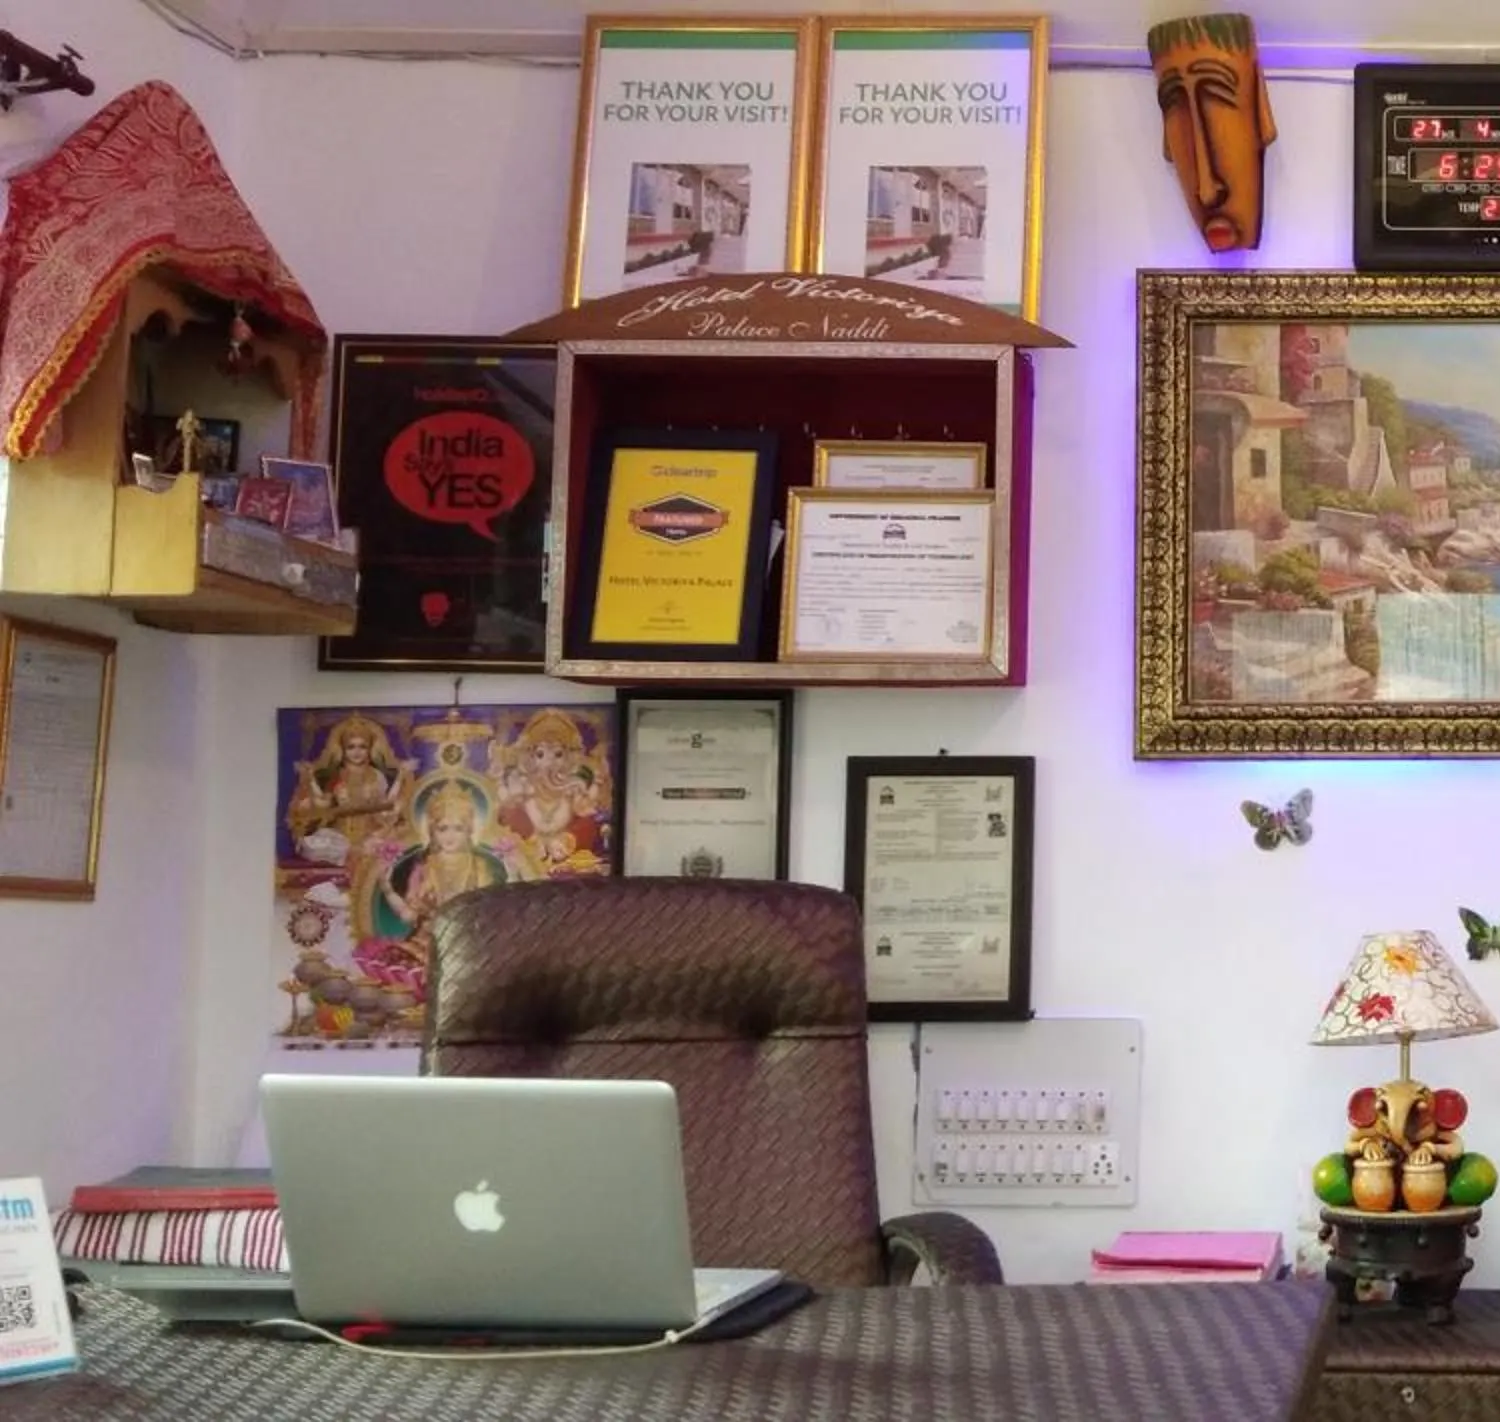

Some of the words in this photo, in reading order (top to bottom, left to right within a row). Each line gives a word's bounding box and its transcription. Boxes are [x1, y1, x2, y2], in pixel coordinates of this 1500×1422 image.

[621, 81, 713, 101] THANK
[720, 81, 775, 101] YOU
[855, 82, 947, 102] THANK
[953, 83, 1008, 103] YOU
[603, 104, 649, 122] FOR
[655, 104, 718, 123] YOUR
[726, 105, 789, 124] VISIT!
[838, 106, 884, 124] FOR
[890, 106, 953, 125] YOUR
[959, 107, 1022, 125] VISIT!
[1412, 119, 1442, 139] 27
[1476, 119, 1490, 138] 4
[617, 281, 765, 328] Hotel
[687, 312, 781, 338] Palace
[419, 427, 504, 458] India
[418, 472, 502, 509] YES
